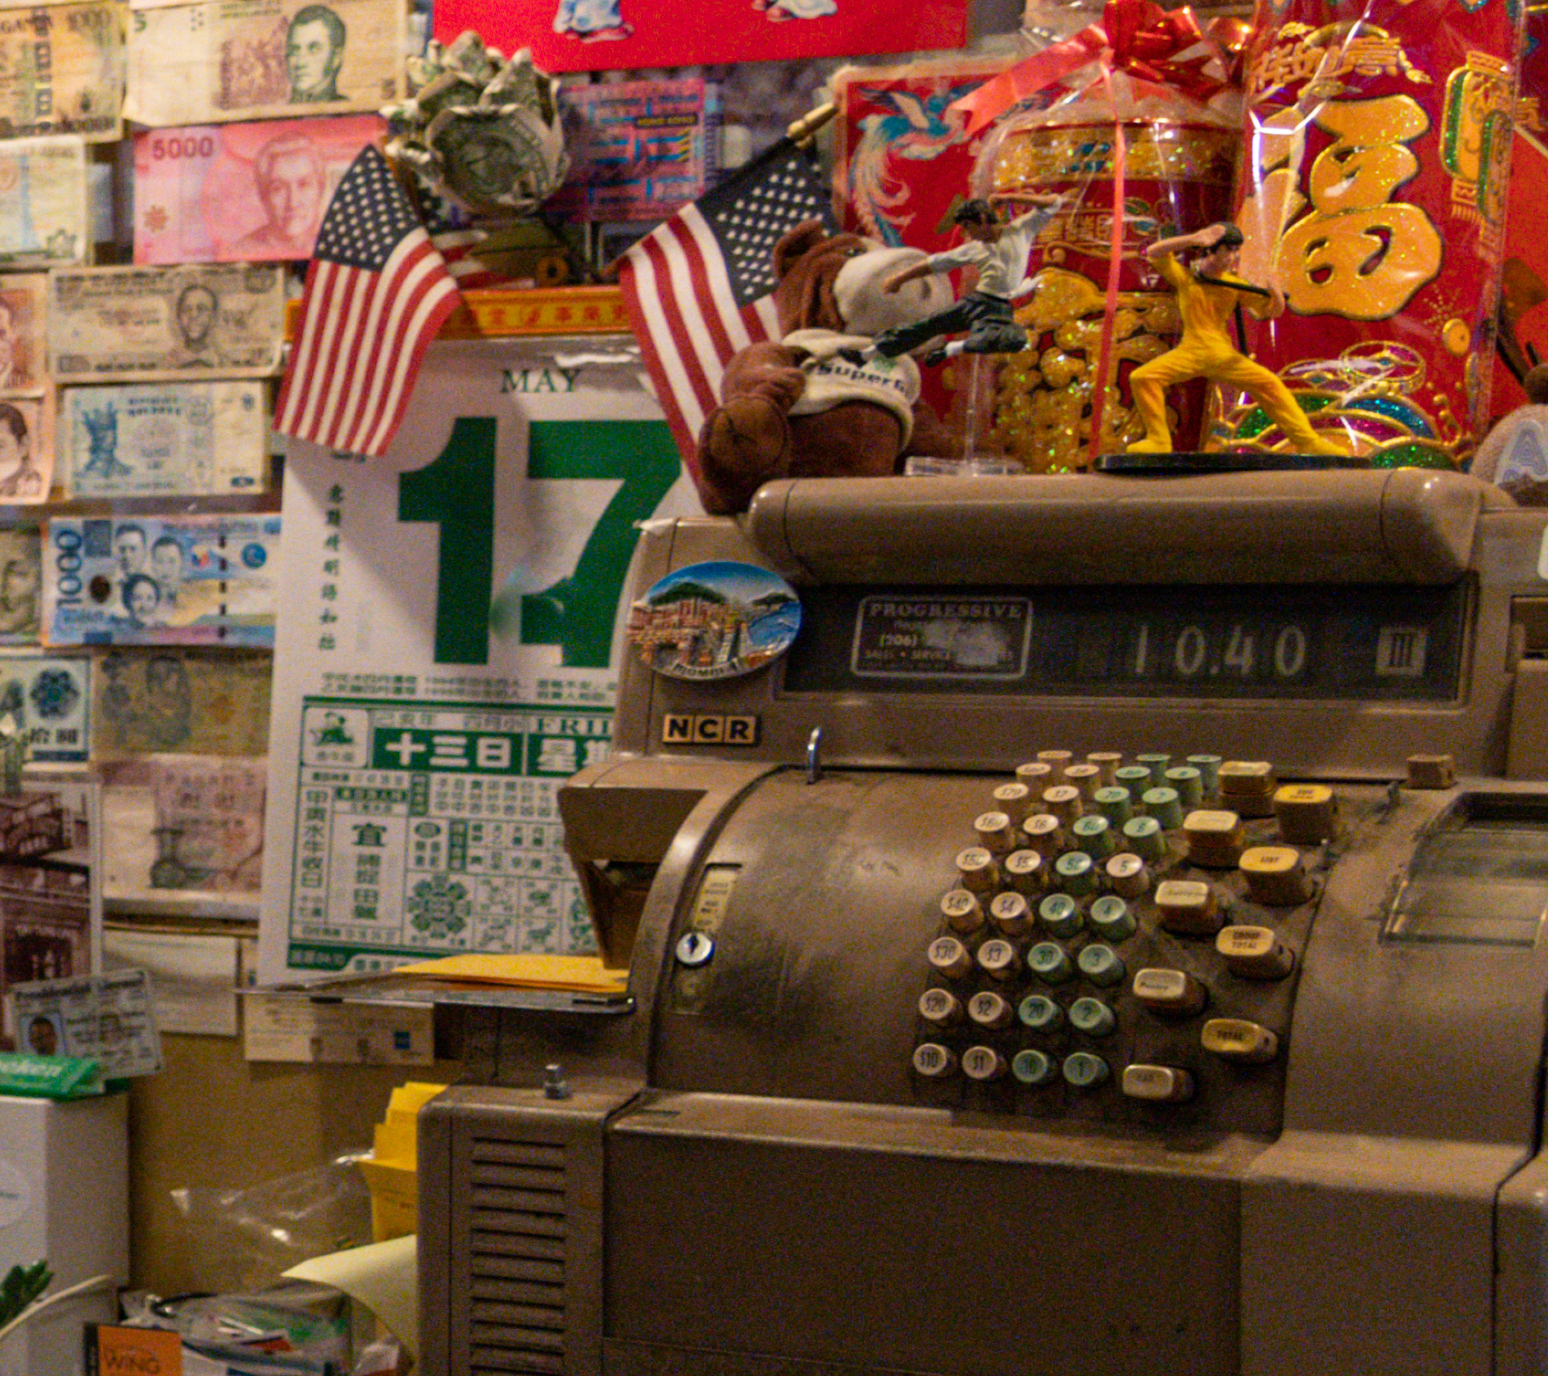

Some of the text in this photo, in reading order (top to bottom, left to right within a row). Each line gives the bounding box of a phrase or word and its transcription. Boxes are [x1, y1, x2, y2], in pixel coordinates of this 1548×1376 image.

[150, 135, 215, 161] 5000
[1238, 94, 1444, 321] 福
[500, 368, 583, 394] MAY
[398, 417, 683, 668] 17
[667, 717, 750, 741] NCR
[384, 732, 513, 769] 十三日
